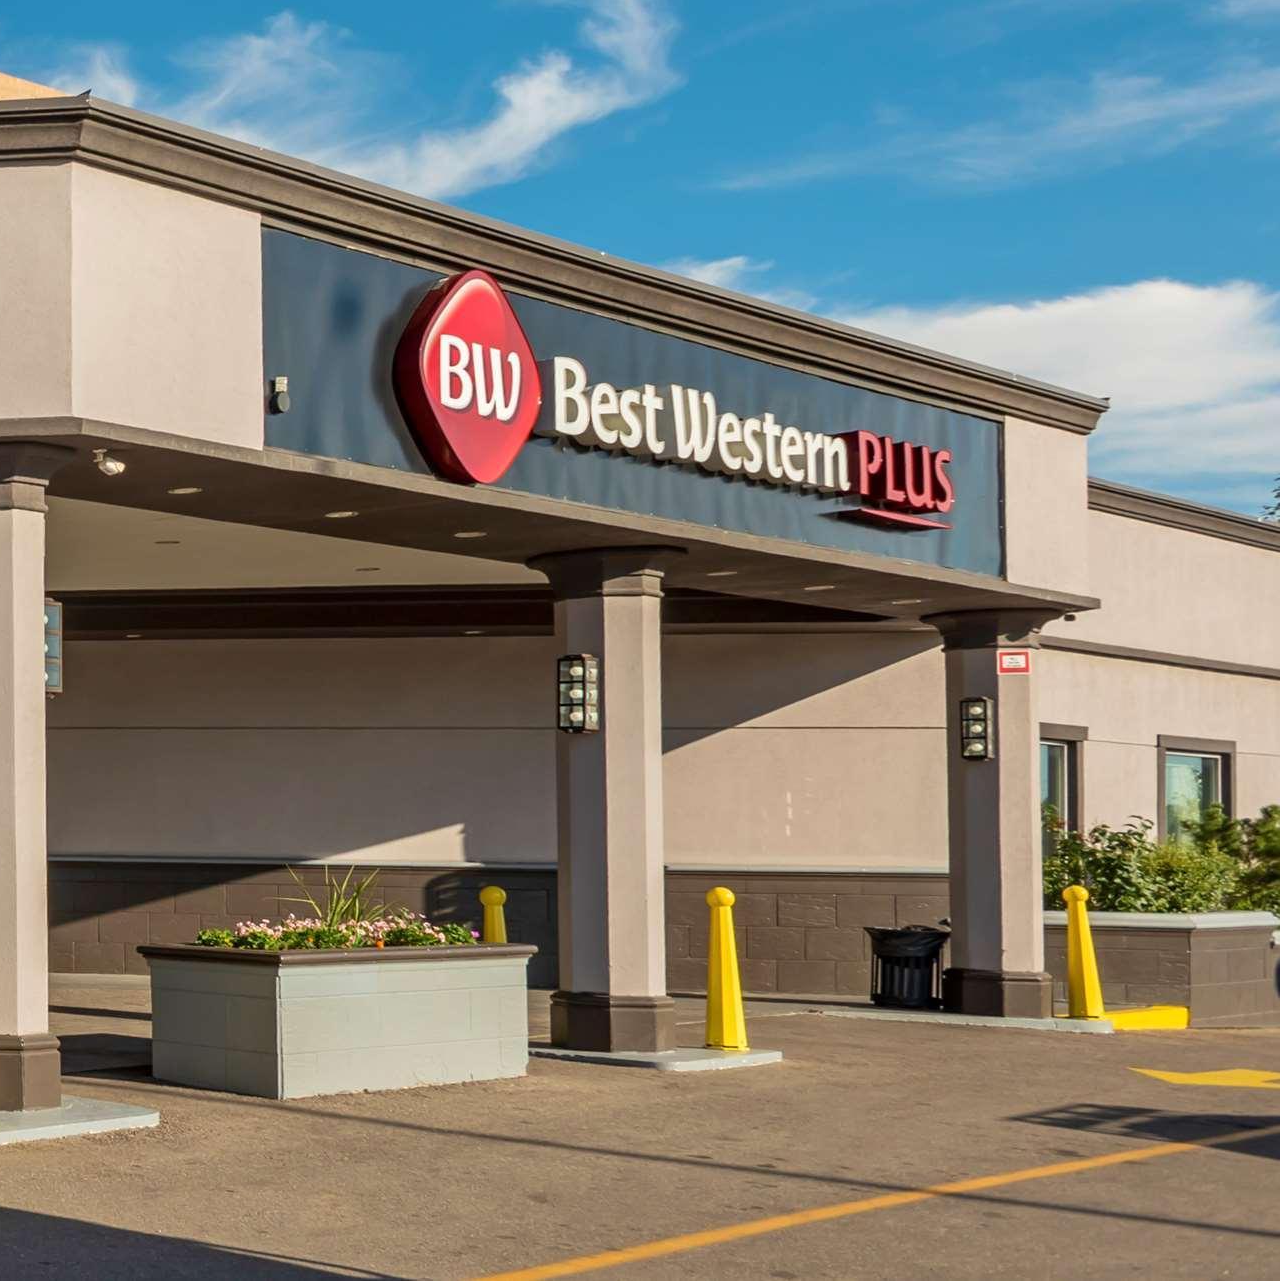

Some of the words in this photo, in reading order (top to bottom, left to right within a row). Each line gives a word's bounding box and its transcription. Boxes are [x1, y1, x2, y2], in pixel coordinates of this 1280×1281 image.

[440, 333, 522, 422] BW
[553, 355, 667, 455] Best
[670, 383, 852, 492] Western
[857, 429, 956, 514] PLUS
